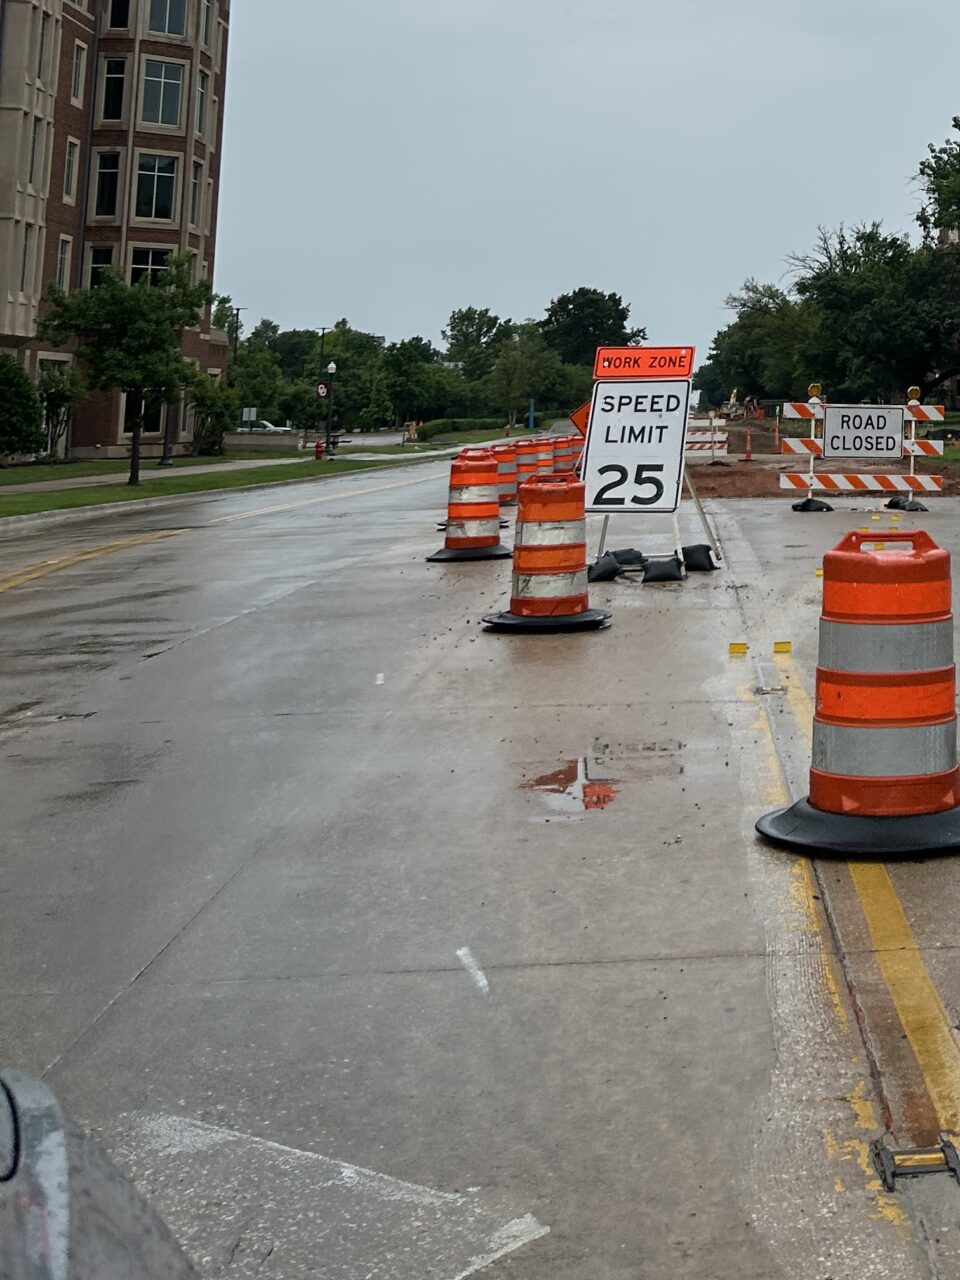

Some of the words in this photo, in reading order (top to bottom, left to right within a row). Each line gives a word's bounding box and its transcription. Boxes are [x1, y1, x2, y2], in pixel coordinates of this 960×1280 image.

[602, 356, 641, 369] WORK
[648, 356, 687, 368] ZONE
[600, 394, 681, 413] SPEED
[841, 414, 887, 430] ROAD
[604, 425, 669, 444] LIMIT
[830, 435, 896, 451] CLOSED
[592, 463, 665, 506] 25
